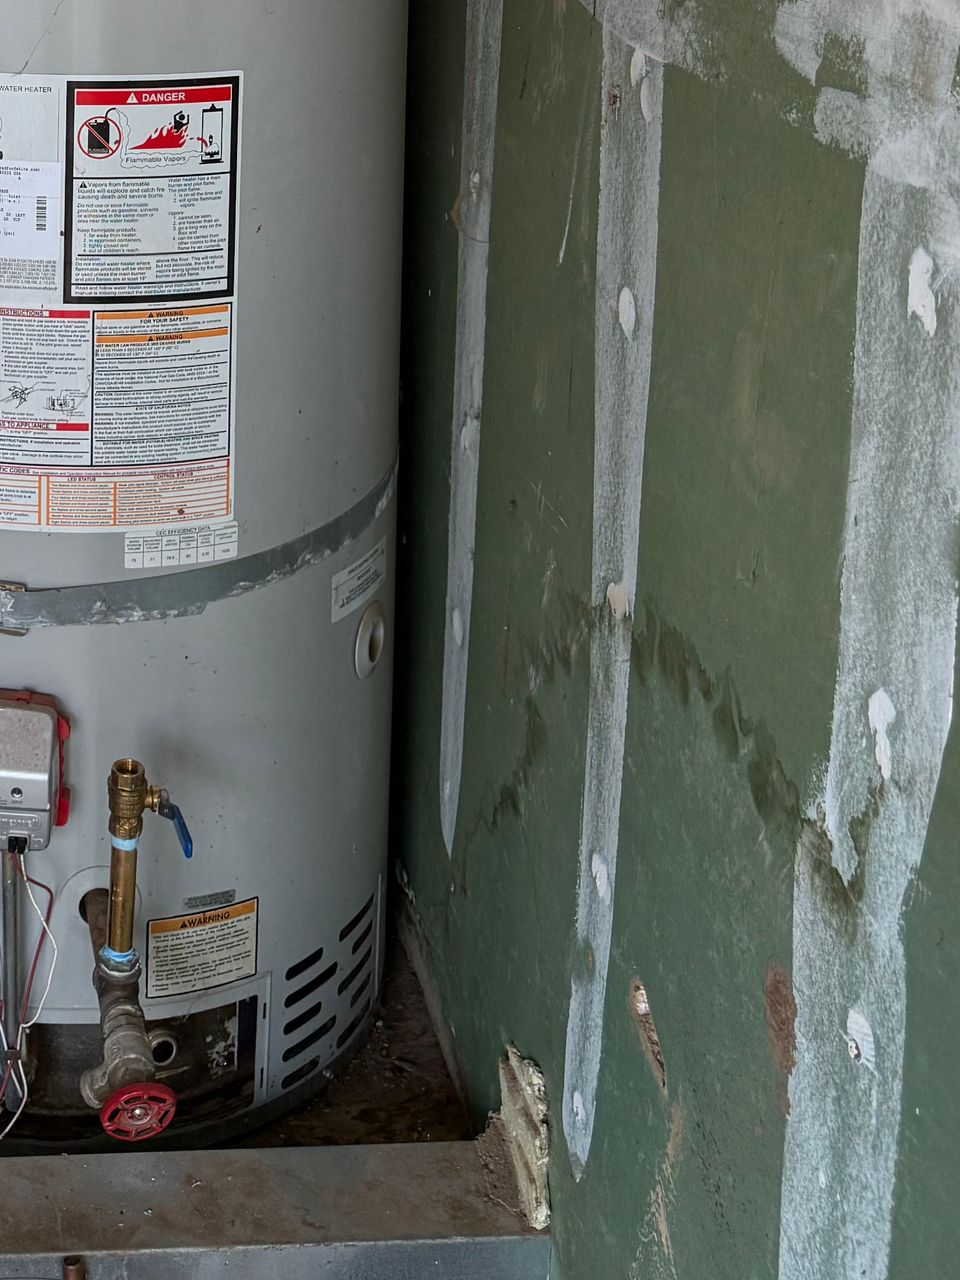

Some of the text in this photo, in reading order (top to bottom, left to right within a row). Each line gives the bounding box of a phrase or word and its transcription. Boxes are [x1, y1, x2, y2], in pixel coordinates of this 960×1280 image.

[142, 93, 185, 102] DANGER
[16, 421, 49, 429] APPLIANCE
[10, 466, 30, 474] CODES
[188, 911, 230, 927] WARNING
